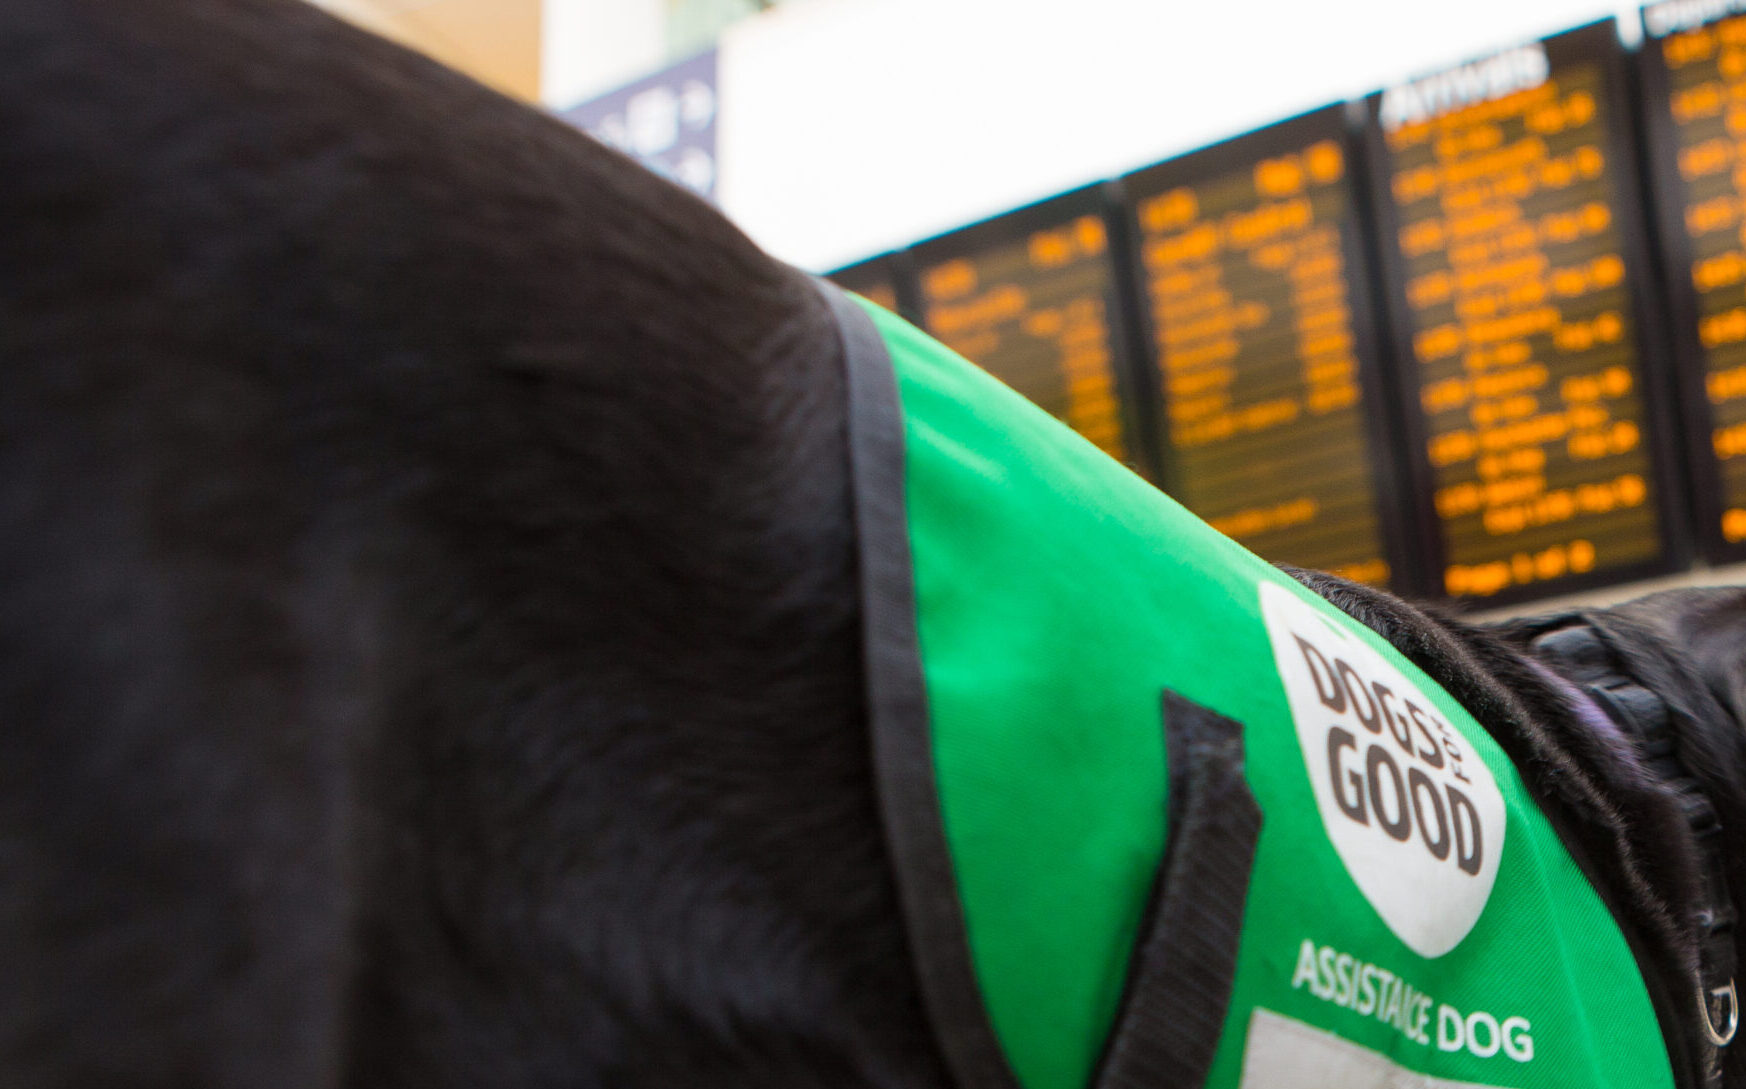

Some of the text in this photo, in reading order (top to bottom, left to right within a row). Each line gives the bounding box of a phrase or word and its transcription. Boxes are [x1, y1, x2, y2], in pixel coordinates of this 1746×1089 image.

[1291, 630, 1472, 786] DOGS FOR
[1327, 726, 1483, 877] GOOD
[1437, 1003, 1534, 1063] DOG
